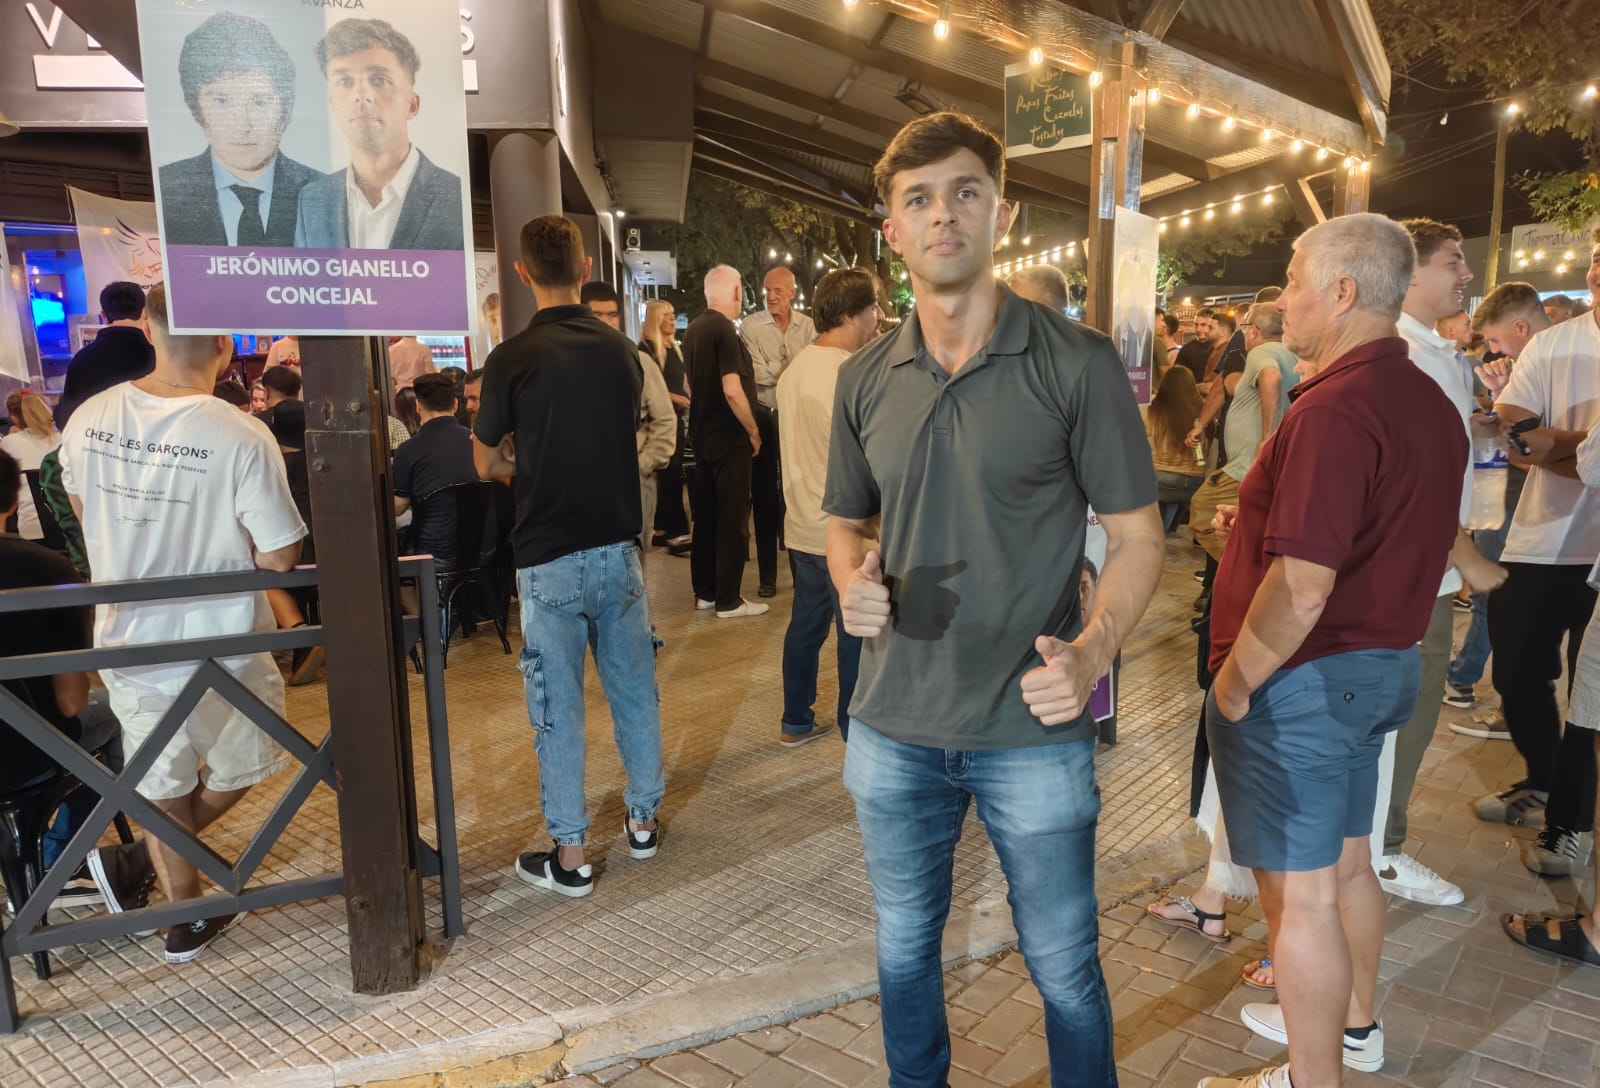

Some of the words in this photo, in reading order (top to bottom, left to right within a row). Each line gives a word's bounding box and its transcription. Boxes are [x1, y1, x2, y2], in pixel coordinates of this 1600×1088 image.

[300, 0, 364, 9] AVANZA
[1044, 86, 1074, 105] Fritas
[1043, 102, 1083, 123] Cazuelas
[206, 252, 320, 277] JERÓNIMO
[326, 259, 430, 279] GIANELLO
[266, 286, 378, 305] CONCEJAL
[85, 427, 114, 444] CHEZ
[119, 436, 141, 451] LES
